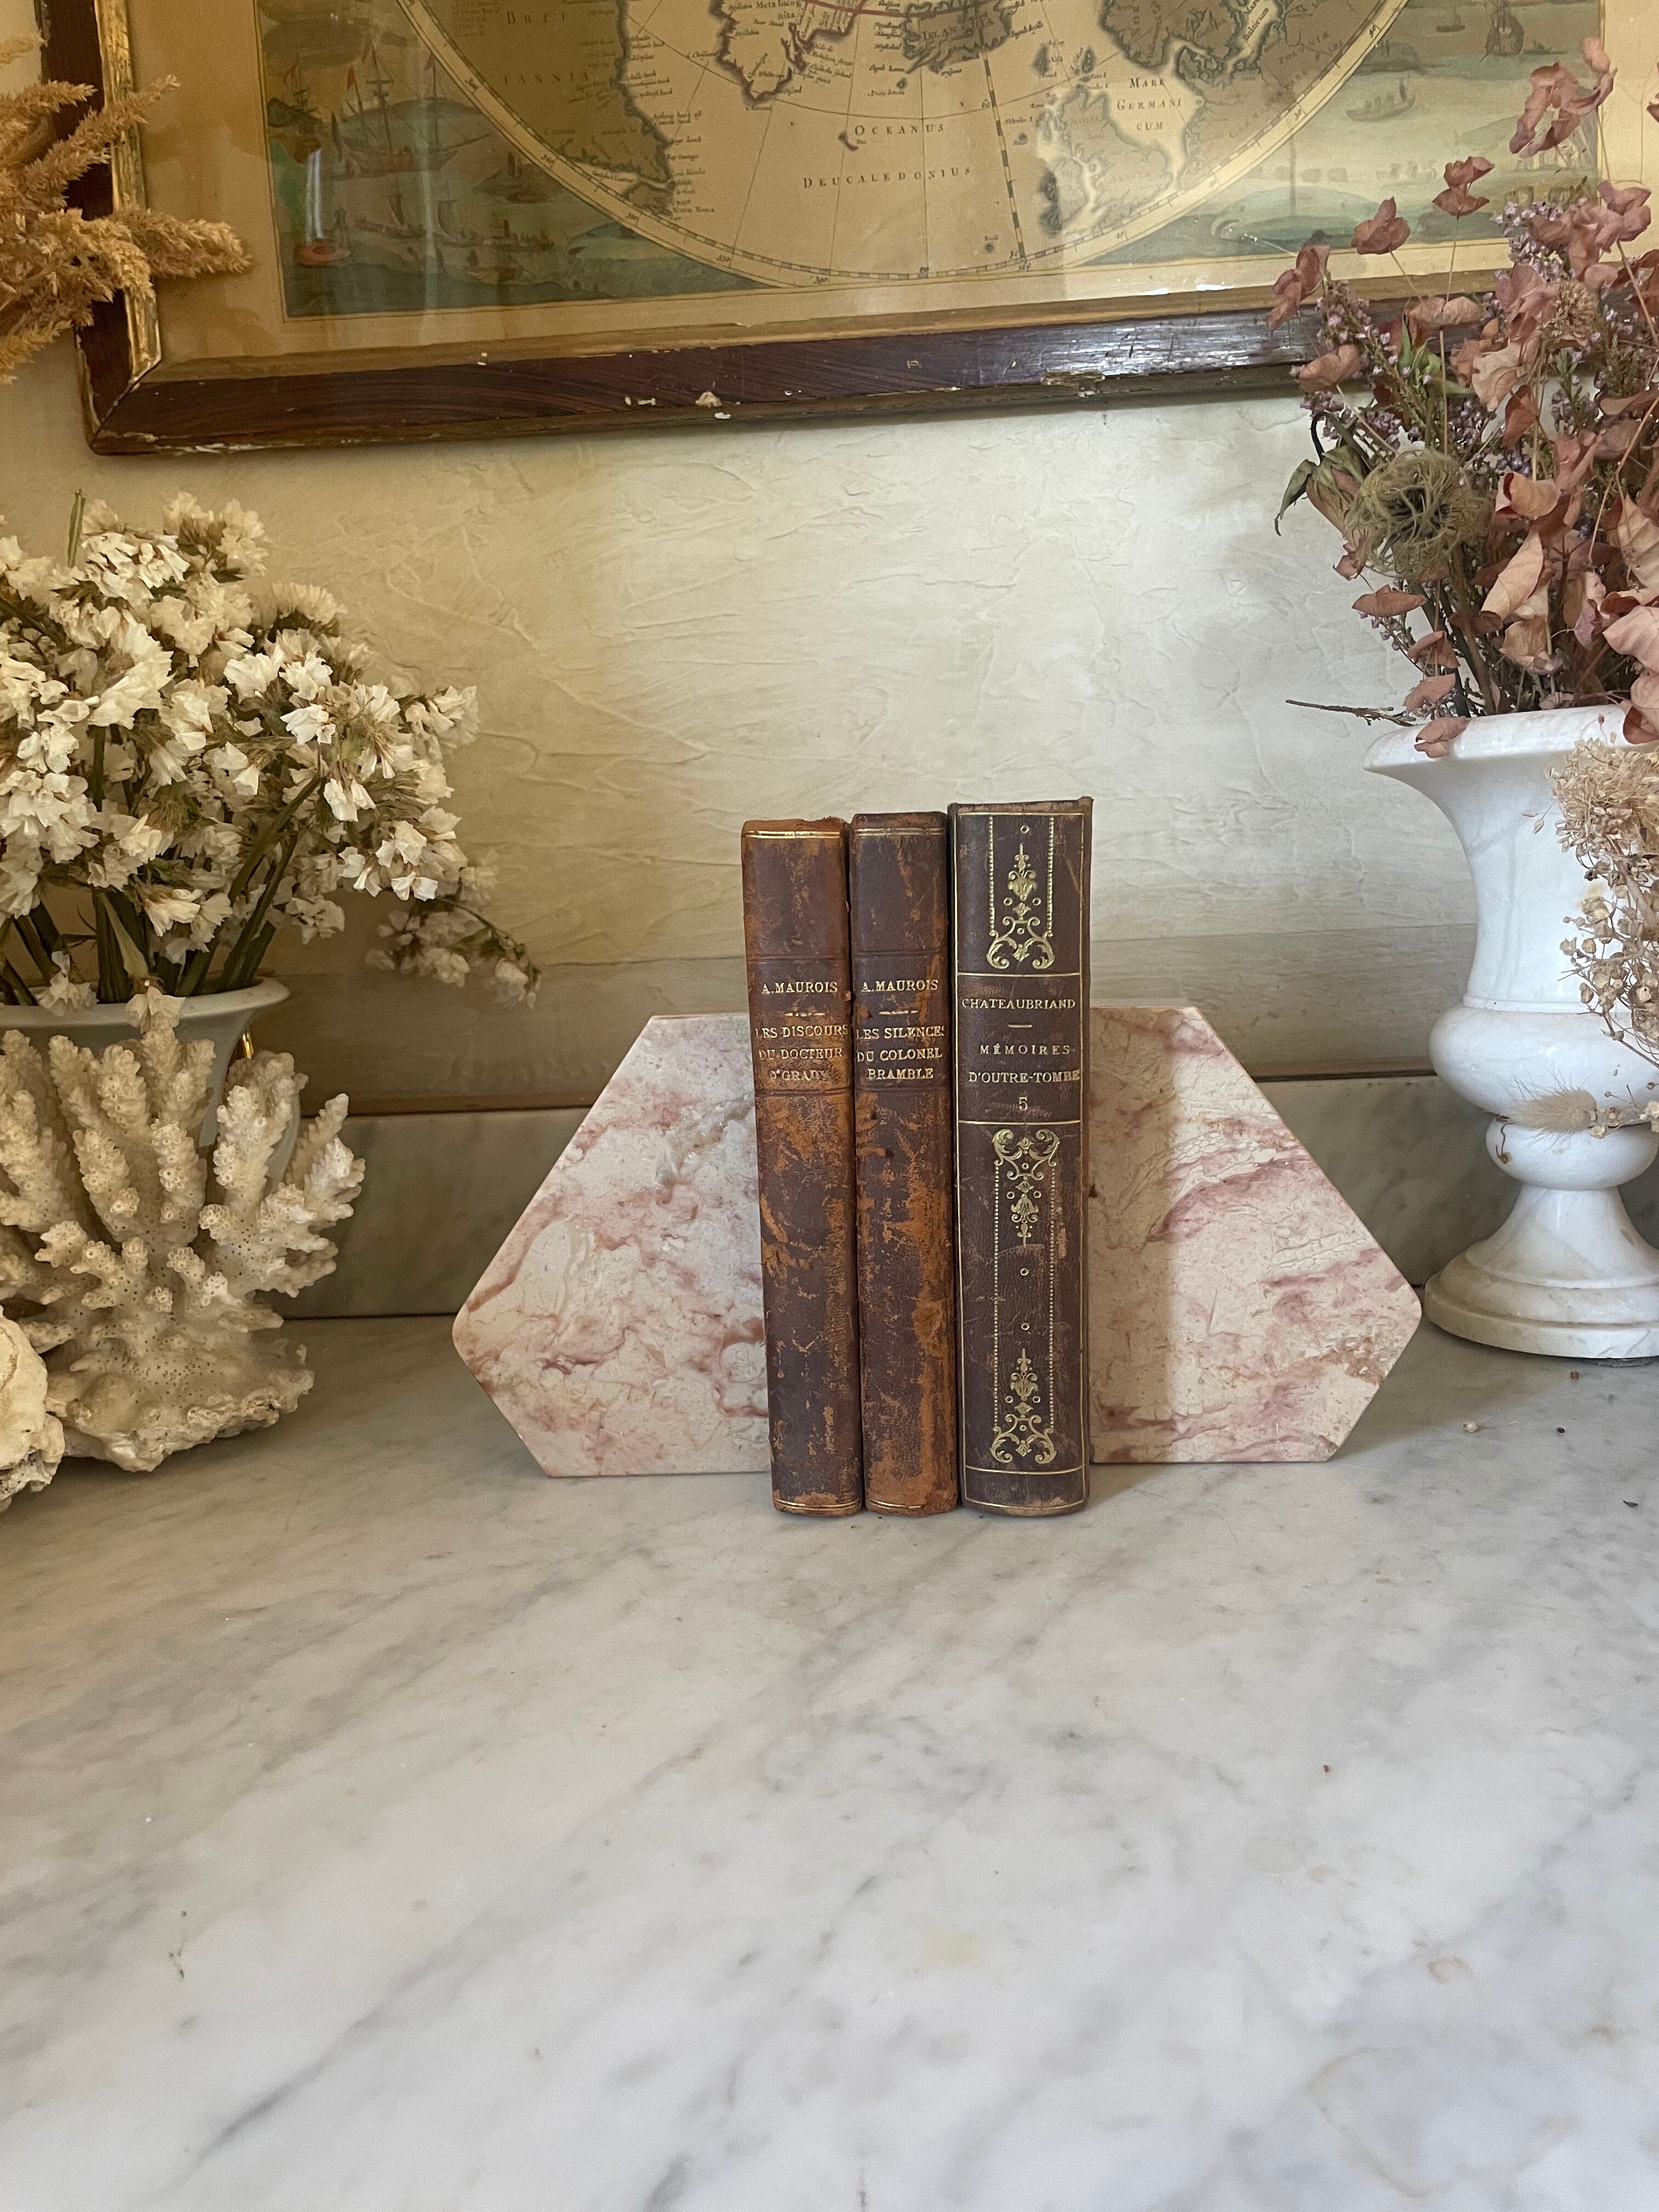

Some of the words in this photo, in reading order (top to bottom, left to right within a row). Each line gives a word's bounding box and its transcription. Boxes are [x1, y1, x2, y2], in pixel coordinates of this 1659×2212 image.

[1117, 99, 1182, 110] GERMANI
[855, 123, 944, 136] OCEANUS
[1136, 121, 1164, 131] CUM
[803, 167, 970, 189] DEUCALEDONIUS
[962, 998, 1076, 1009] CHATEAUBRIAND
[781, 1024, 849, 1037] DISCOURS
[856, 1029, 880, 1040] LES
[759, 1049, 775, 1060] DU
[781, 1047, 843, 1059] DOCTEUR
[857, 1051, 874, 1062] DU
[879, 1048, 943, 1061] COLONEL
[980, 1043, 1070, 1055] MÉMOIRES
[867, 1068, 934, 1081] BRAMBLE
[968, 1070, 1080, 1084] D'OUTRE-TOMBE
[1019, 1097, 1028, 1111] 5
